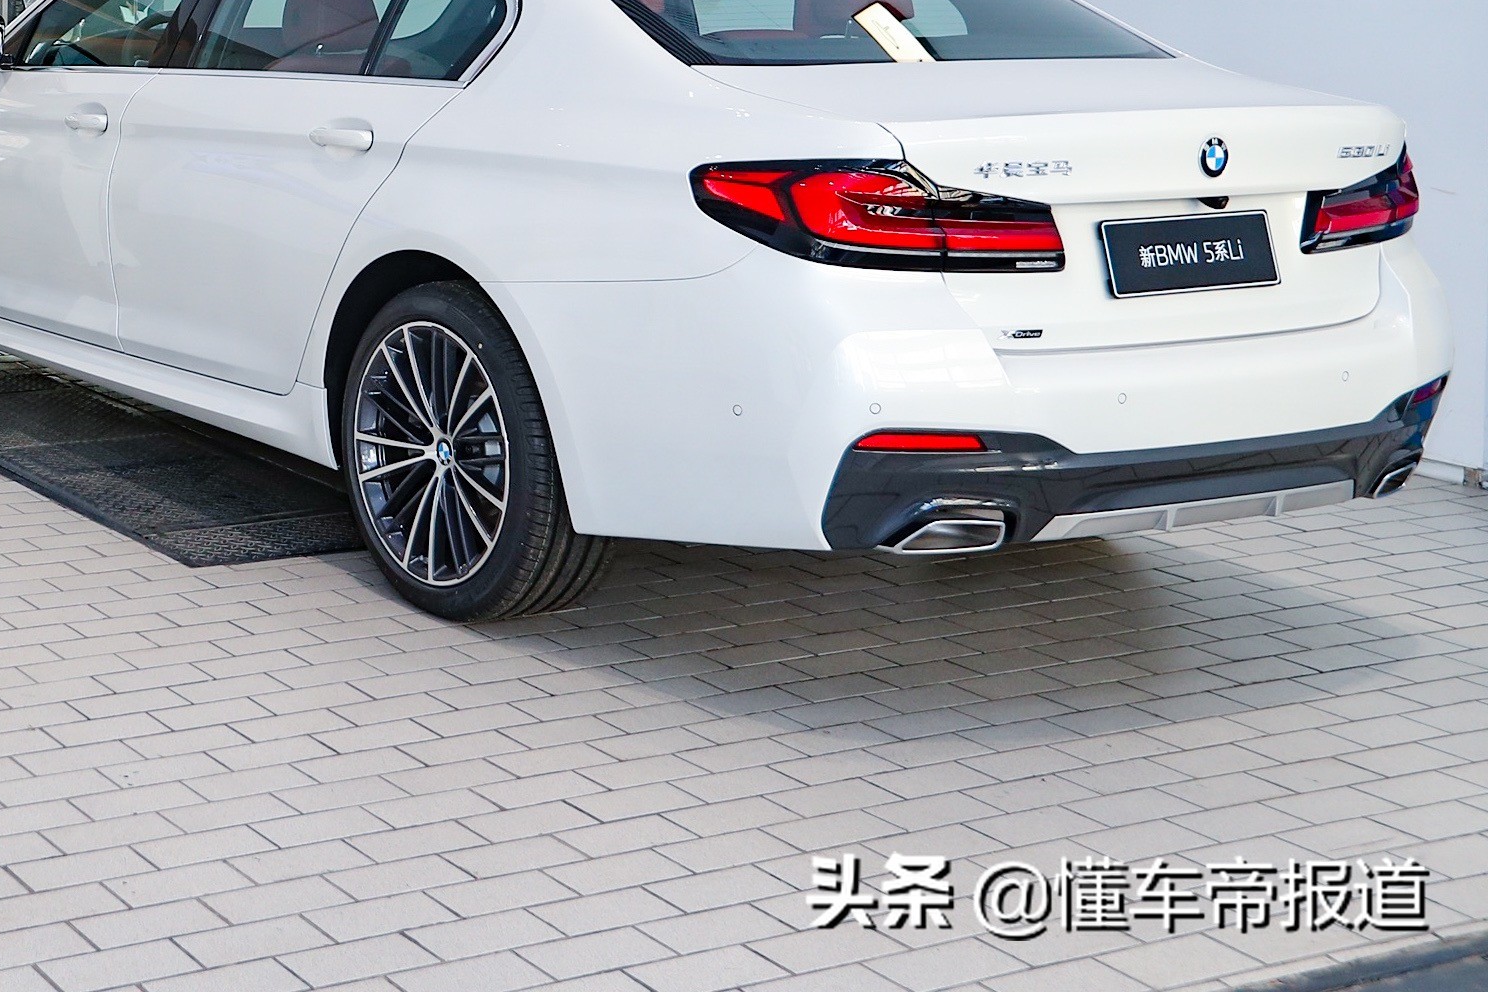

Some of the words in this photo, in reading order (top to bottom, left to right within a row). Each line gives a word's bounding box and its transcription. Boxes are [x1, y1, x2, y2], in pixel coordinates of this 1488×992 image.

[1337, 144, 1390, 158] 530Li
[973, 160, 1072, 178] 华晨宝马
[1138, 242, 1198, 268] 新BMW
[1203, 239, 1244, 263] 5系Li
